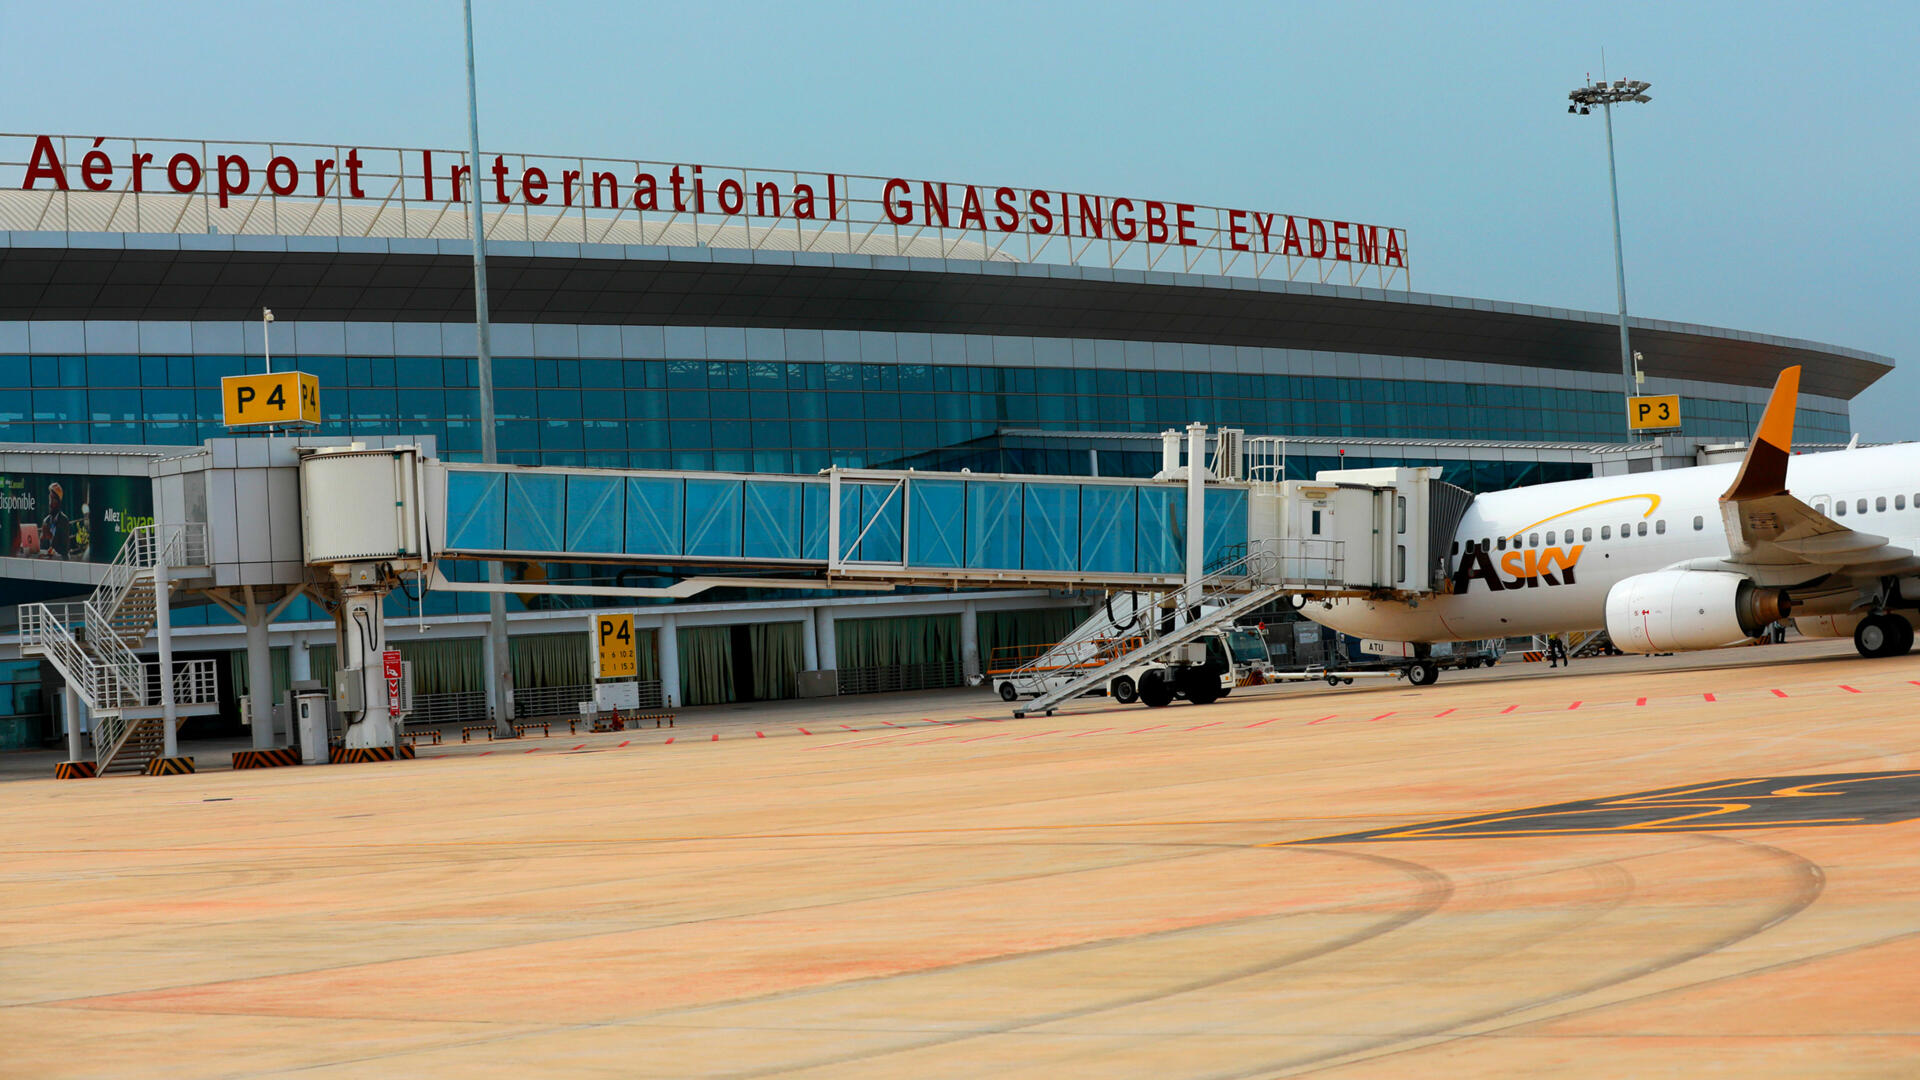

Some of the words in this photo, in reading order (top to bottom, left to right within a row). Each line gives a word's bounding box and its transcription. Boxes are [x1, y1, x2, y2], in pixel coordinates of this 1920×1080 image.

[22, 135, 365, 208] Aéroport
[423, 149, 837, 221] International
[882, 178, 1198, 247] GNASSINGBE
[1229, 209, 1403, 268] EYADEMA
[104, 507, 120, 522] Allez
[1453, 543, 1585, 595] ASKY
[1368, 642, 1384, 652] ATU
